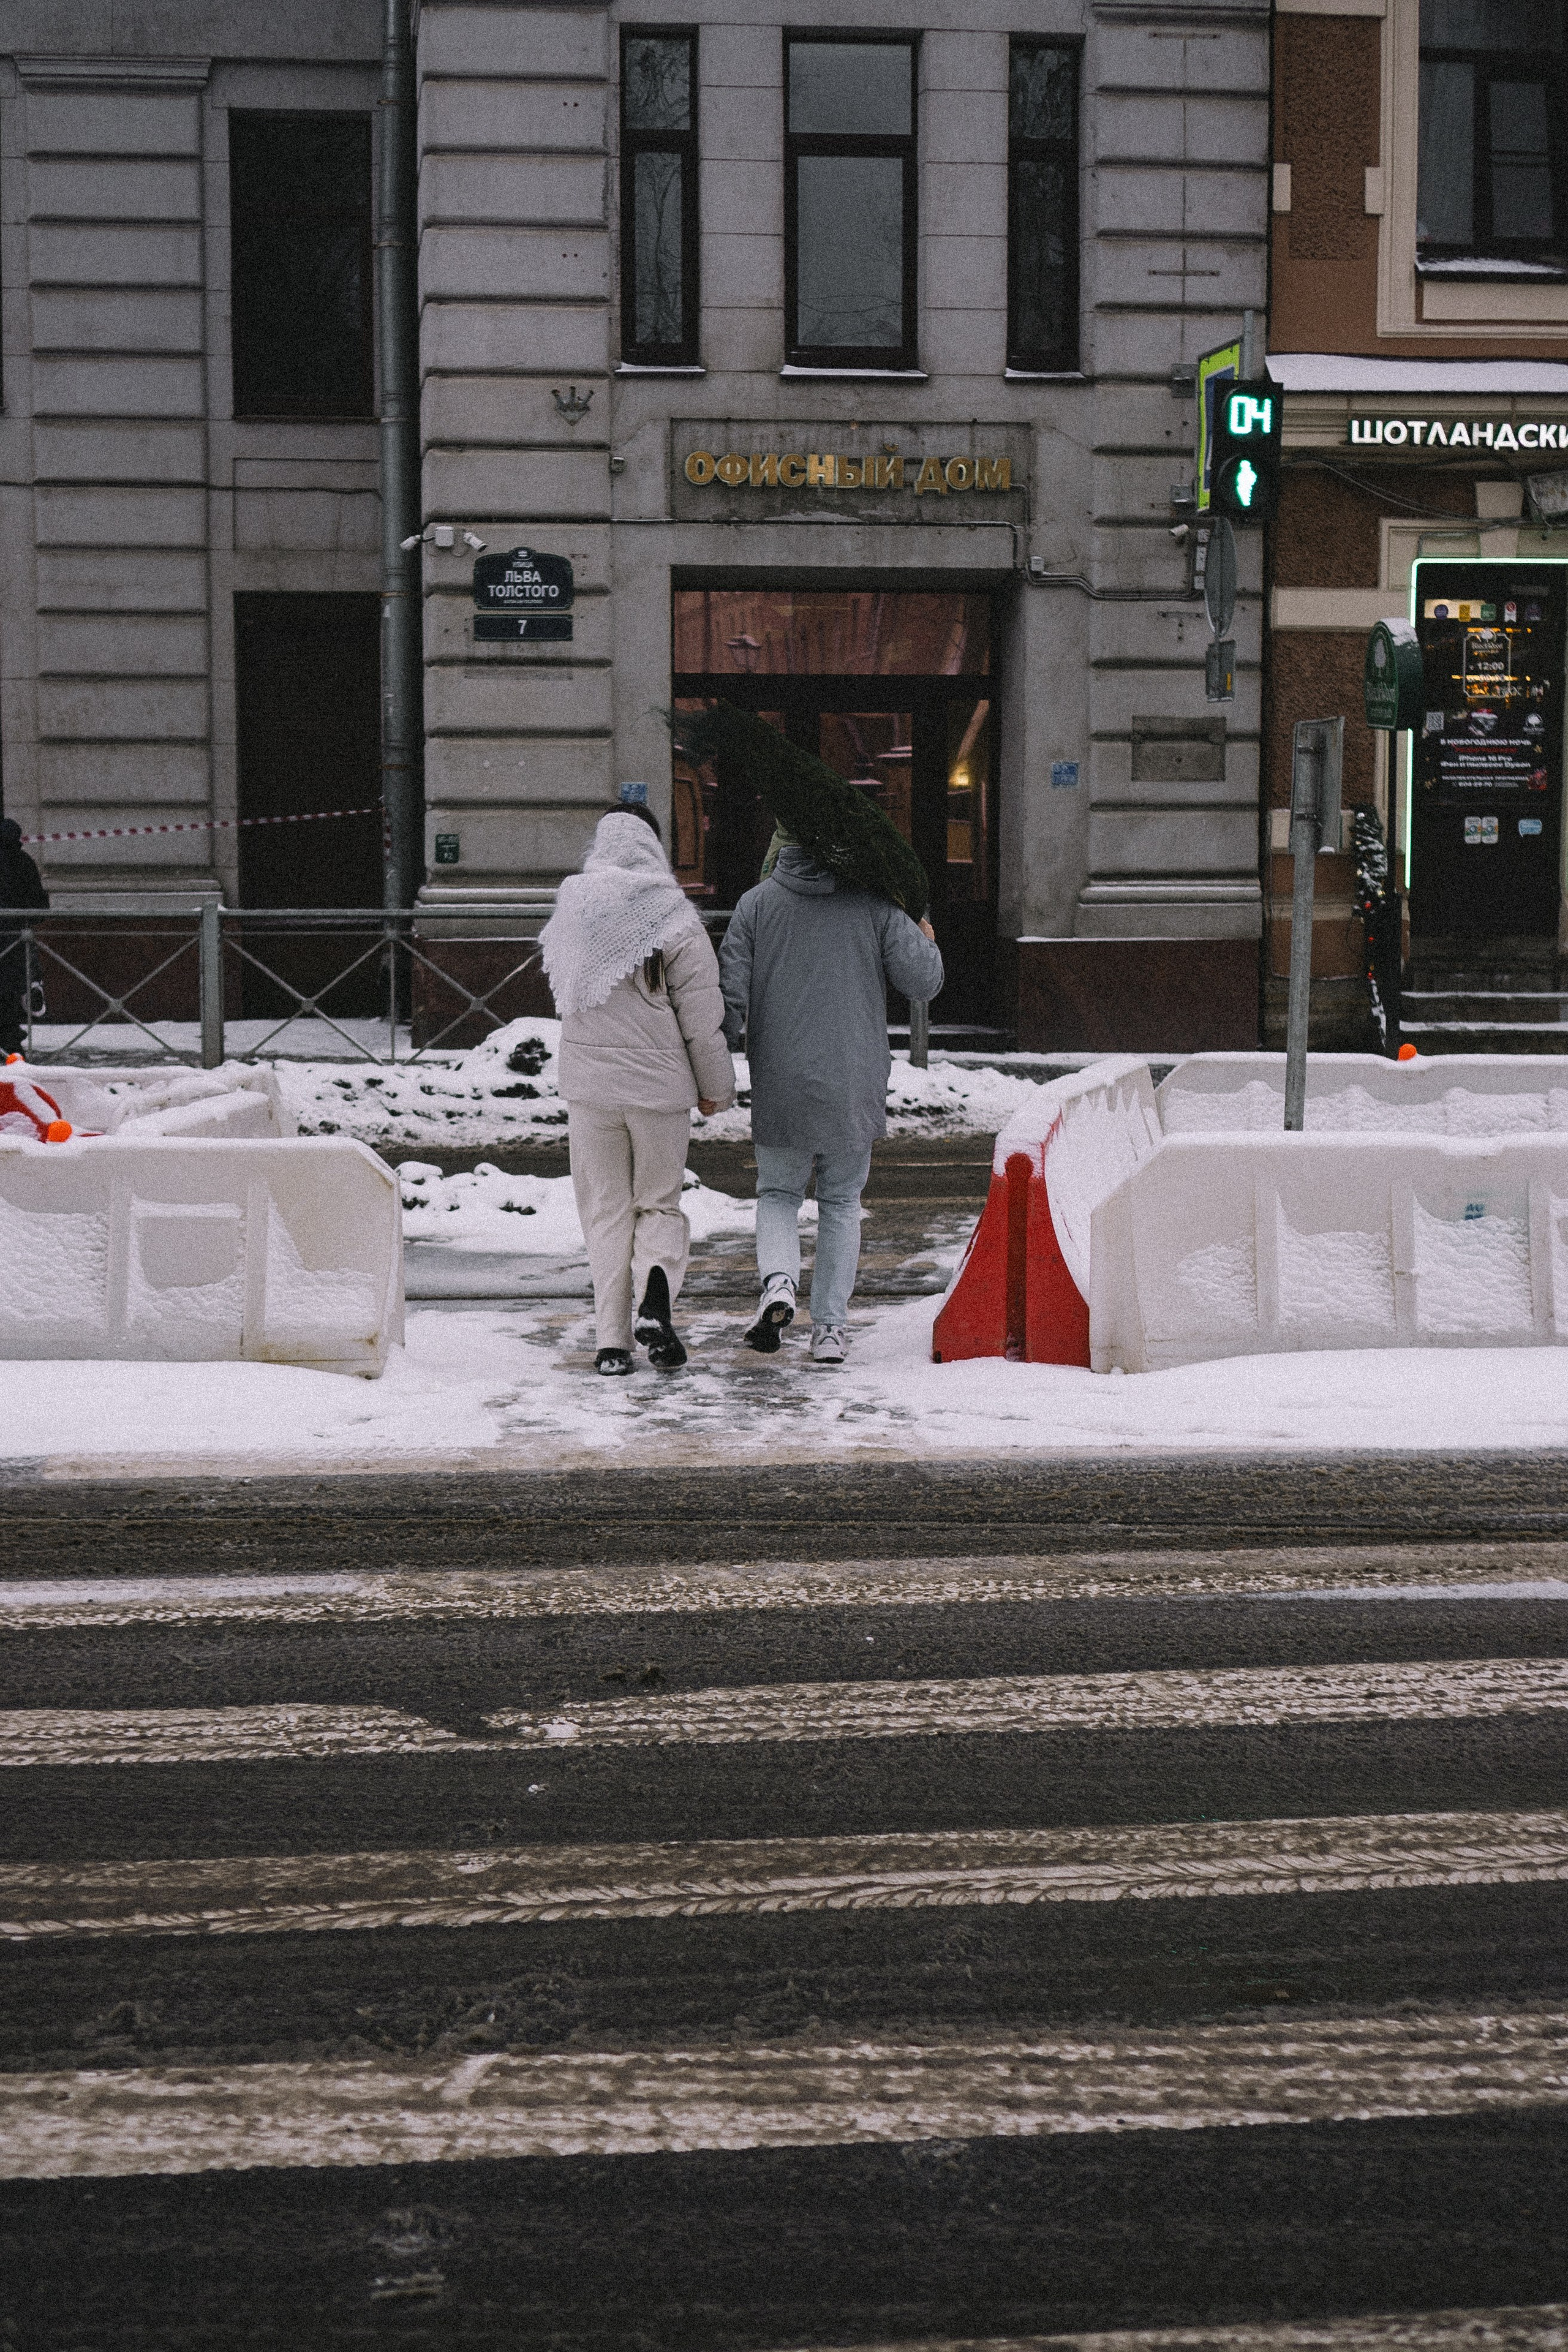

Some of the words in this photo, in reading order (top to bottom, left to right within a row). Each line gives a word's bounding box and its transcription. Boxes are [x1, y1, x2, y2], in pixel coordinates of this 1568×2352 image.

[1230, 396, 1272, 434] 04
[685, 443, 905, 488] ОФИСНЫЙ
[914, 456, 1012, 495] ДОМ
[504, 570, 541, 582] ЛЬВА
[488, 585, 559, 597] ТОЛСТОГО
[518, 619, 527, 635] 7
